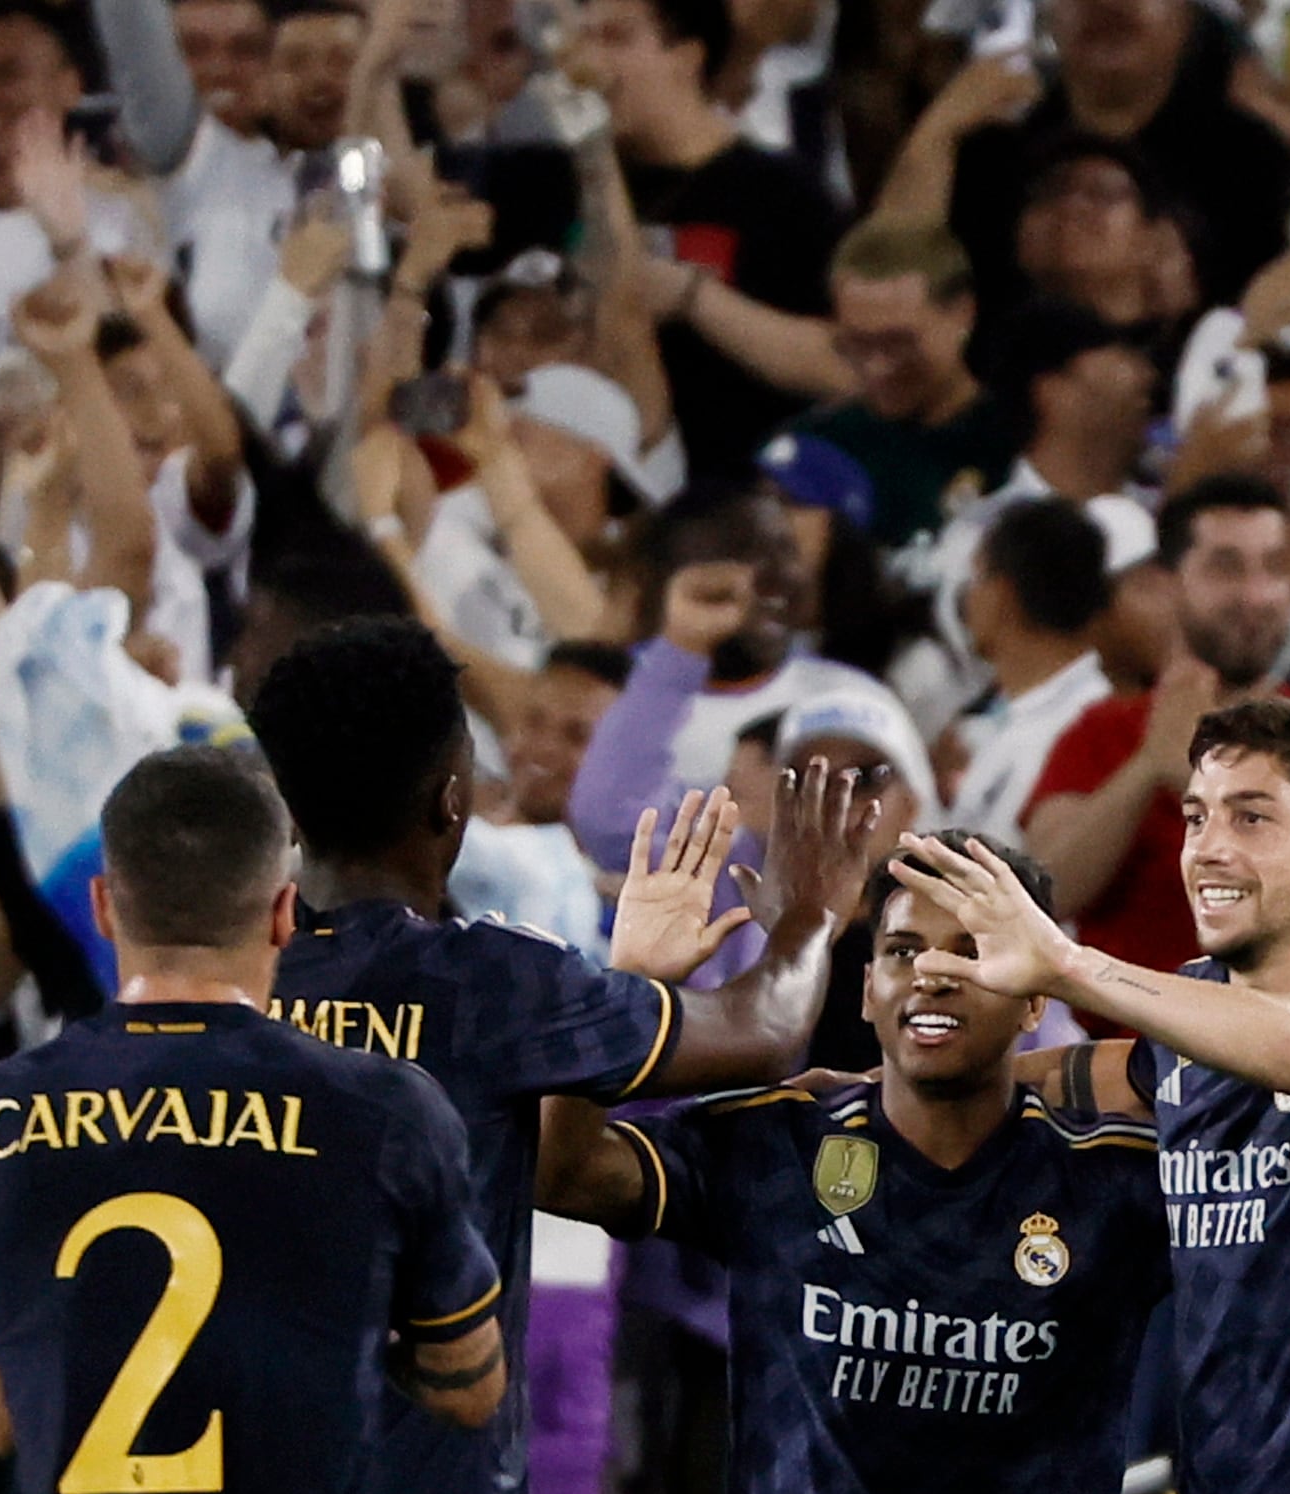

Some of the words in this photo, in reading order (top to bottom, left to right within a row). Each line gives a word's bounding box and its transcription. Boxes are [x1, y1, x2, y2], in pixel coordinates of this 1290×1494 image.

[1185, 1198, 1266, 1248] BETTER
[803, 1283, 1059, 1363] Emirates
[831, 1355, 890, 1403] FLY
[897, 1364, 1020, 1415] BETTER
